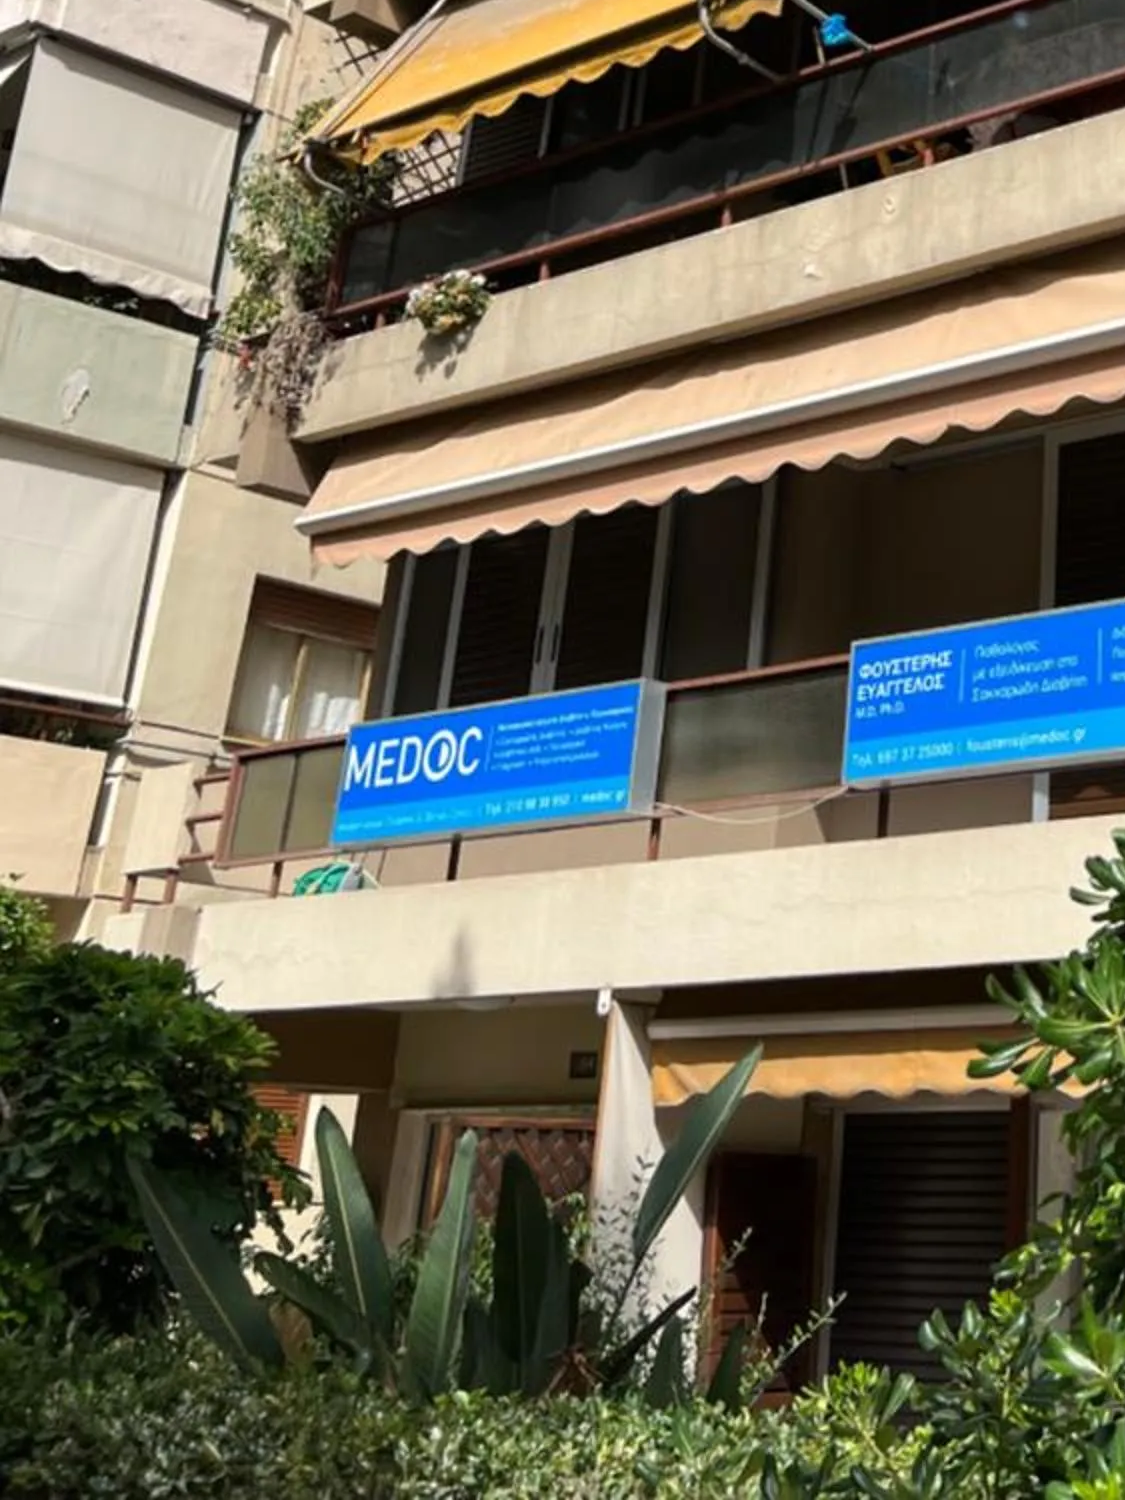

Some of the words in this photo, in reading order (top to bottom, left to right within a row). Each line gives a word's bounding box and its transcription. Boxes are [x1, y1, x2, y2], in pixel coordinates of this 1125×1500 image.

[859, 649, 953, 679] ΦΟΥΣΤΕΡΗΣ
[857, 672, 944, 702] ΕΥΑΓΓΕΛΟΣ
[344, 726, 483, 792] MEDOC
